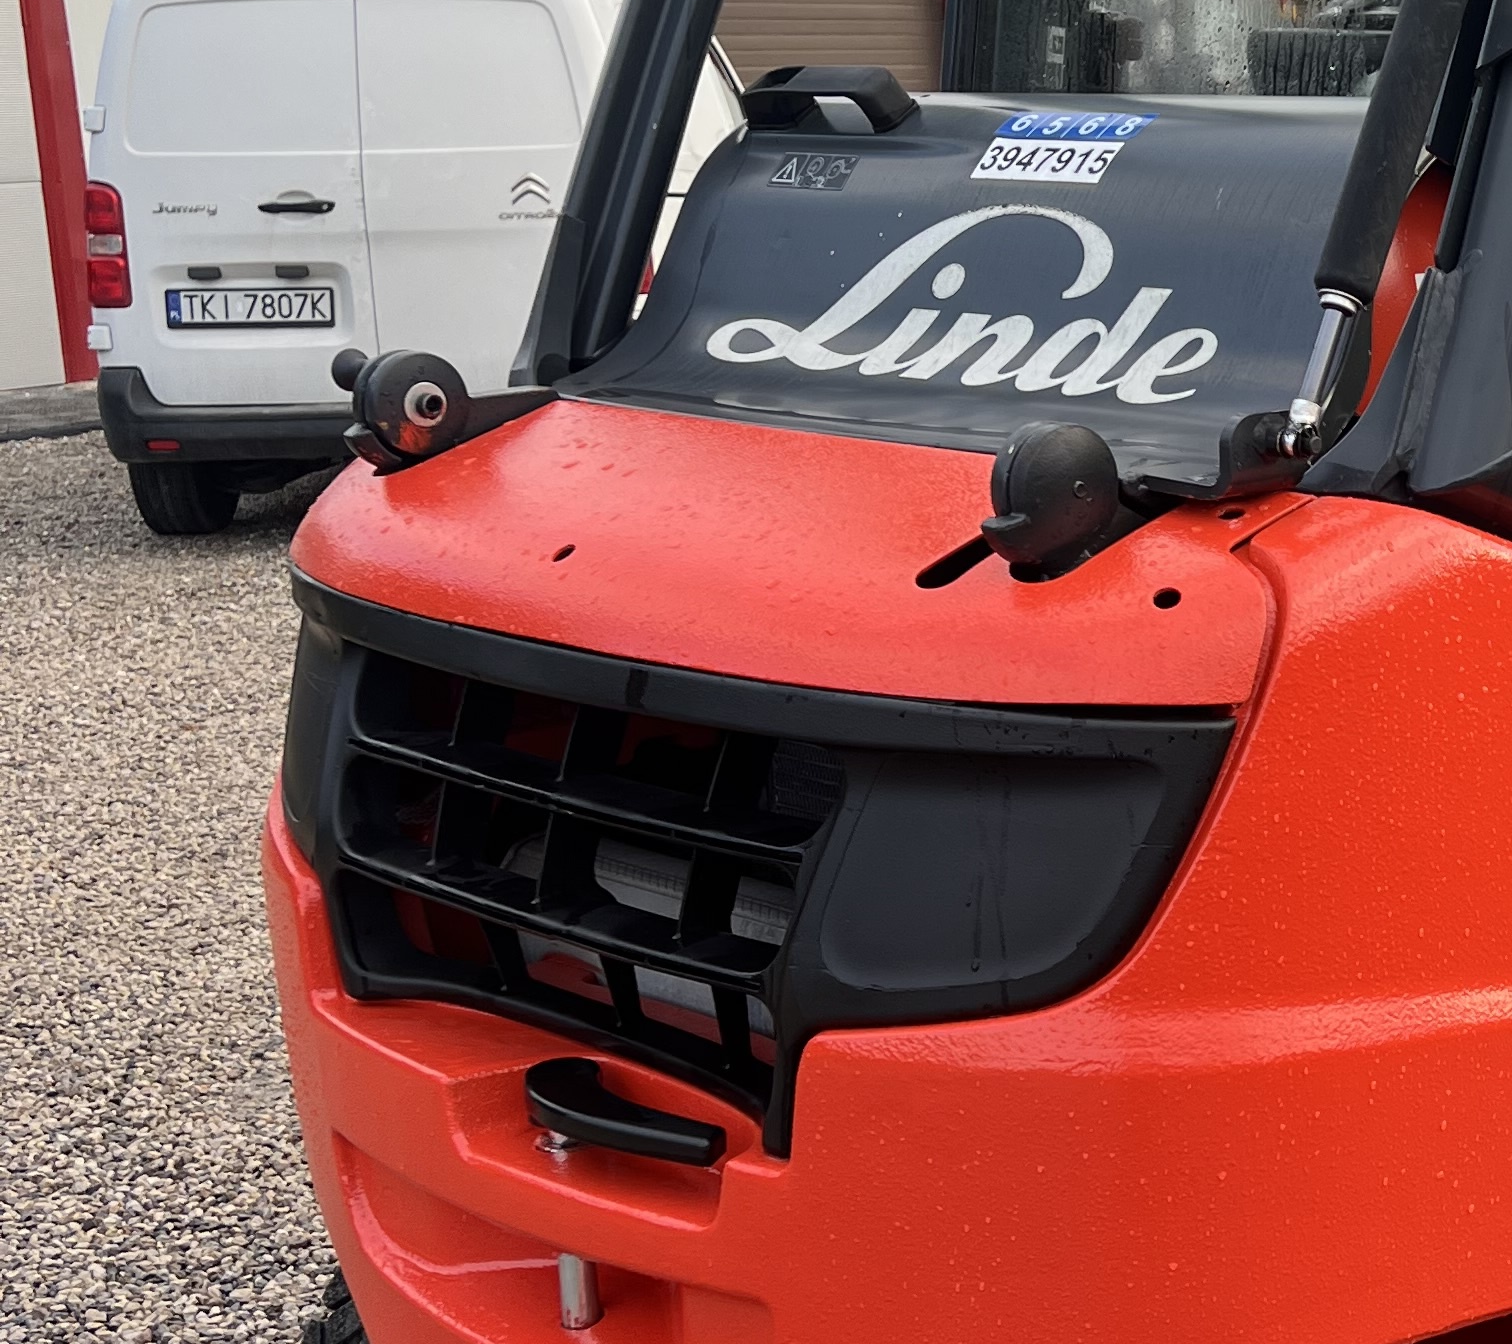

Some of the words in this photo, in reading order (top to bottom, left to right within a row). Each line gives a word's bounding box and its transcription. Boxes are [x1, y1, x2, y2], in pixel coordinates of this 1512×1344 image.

[980, 145, 1116, 176] 3947915
[498, 208, 560, 220] CITROË
[183, 293, 229, 320] TKI
[244, 292, 327, 319] 7807K
[706, 203, 1219, 405] Linde
